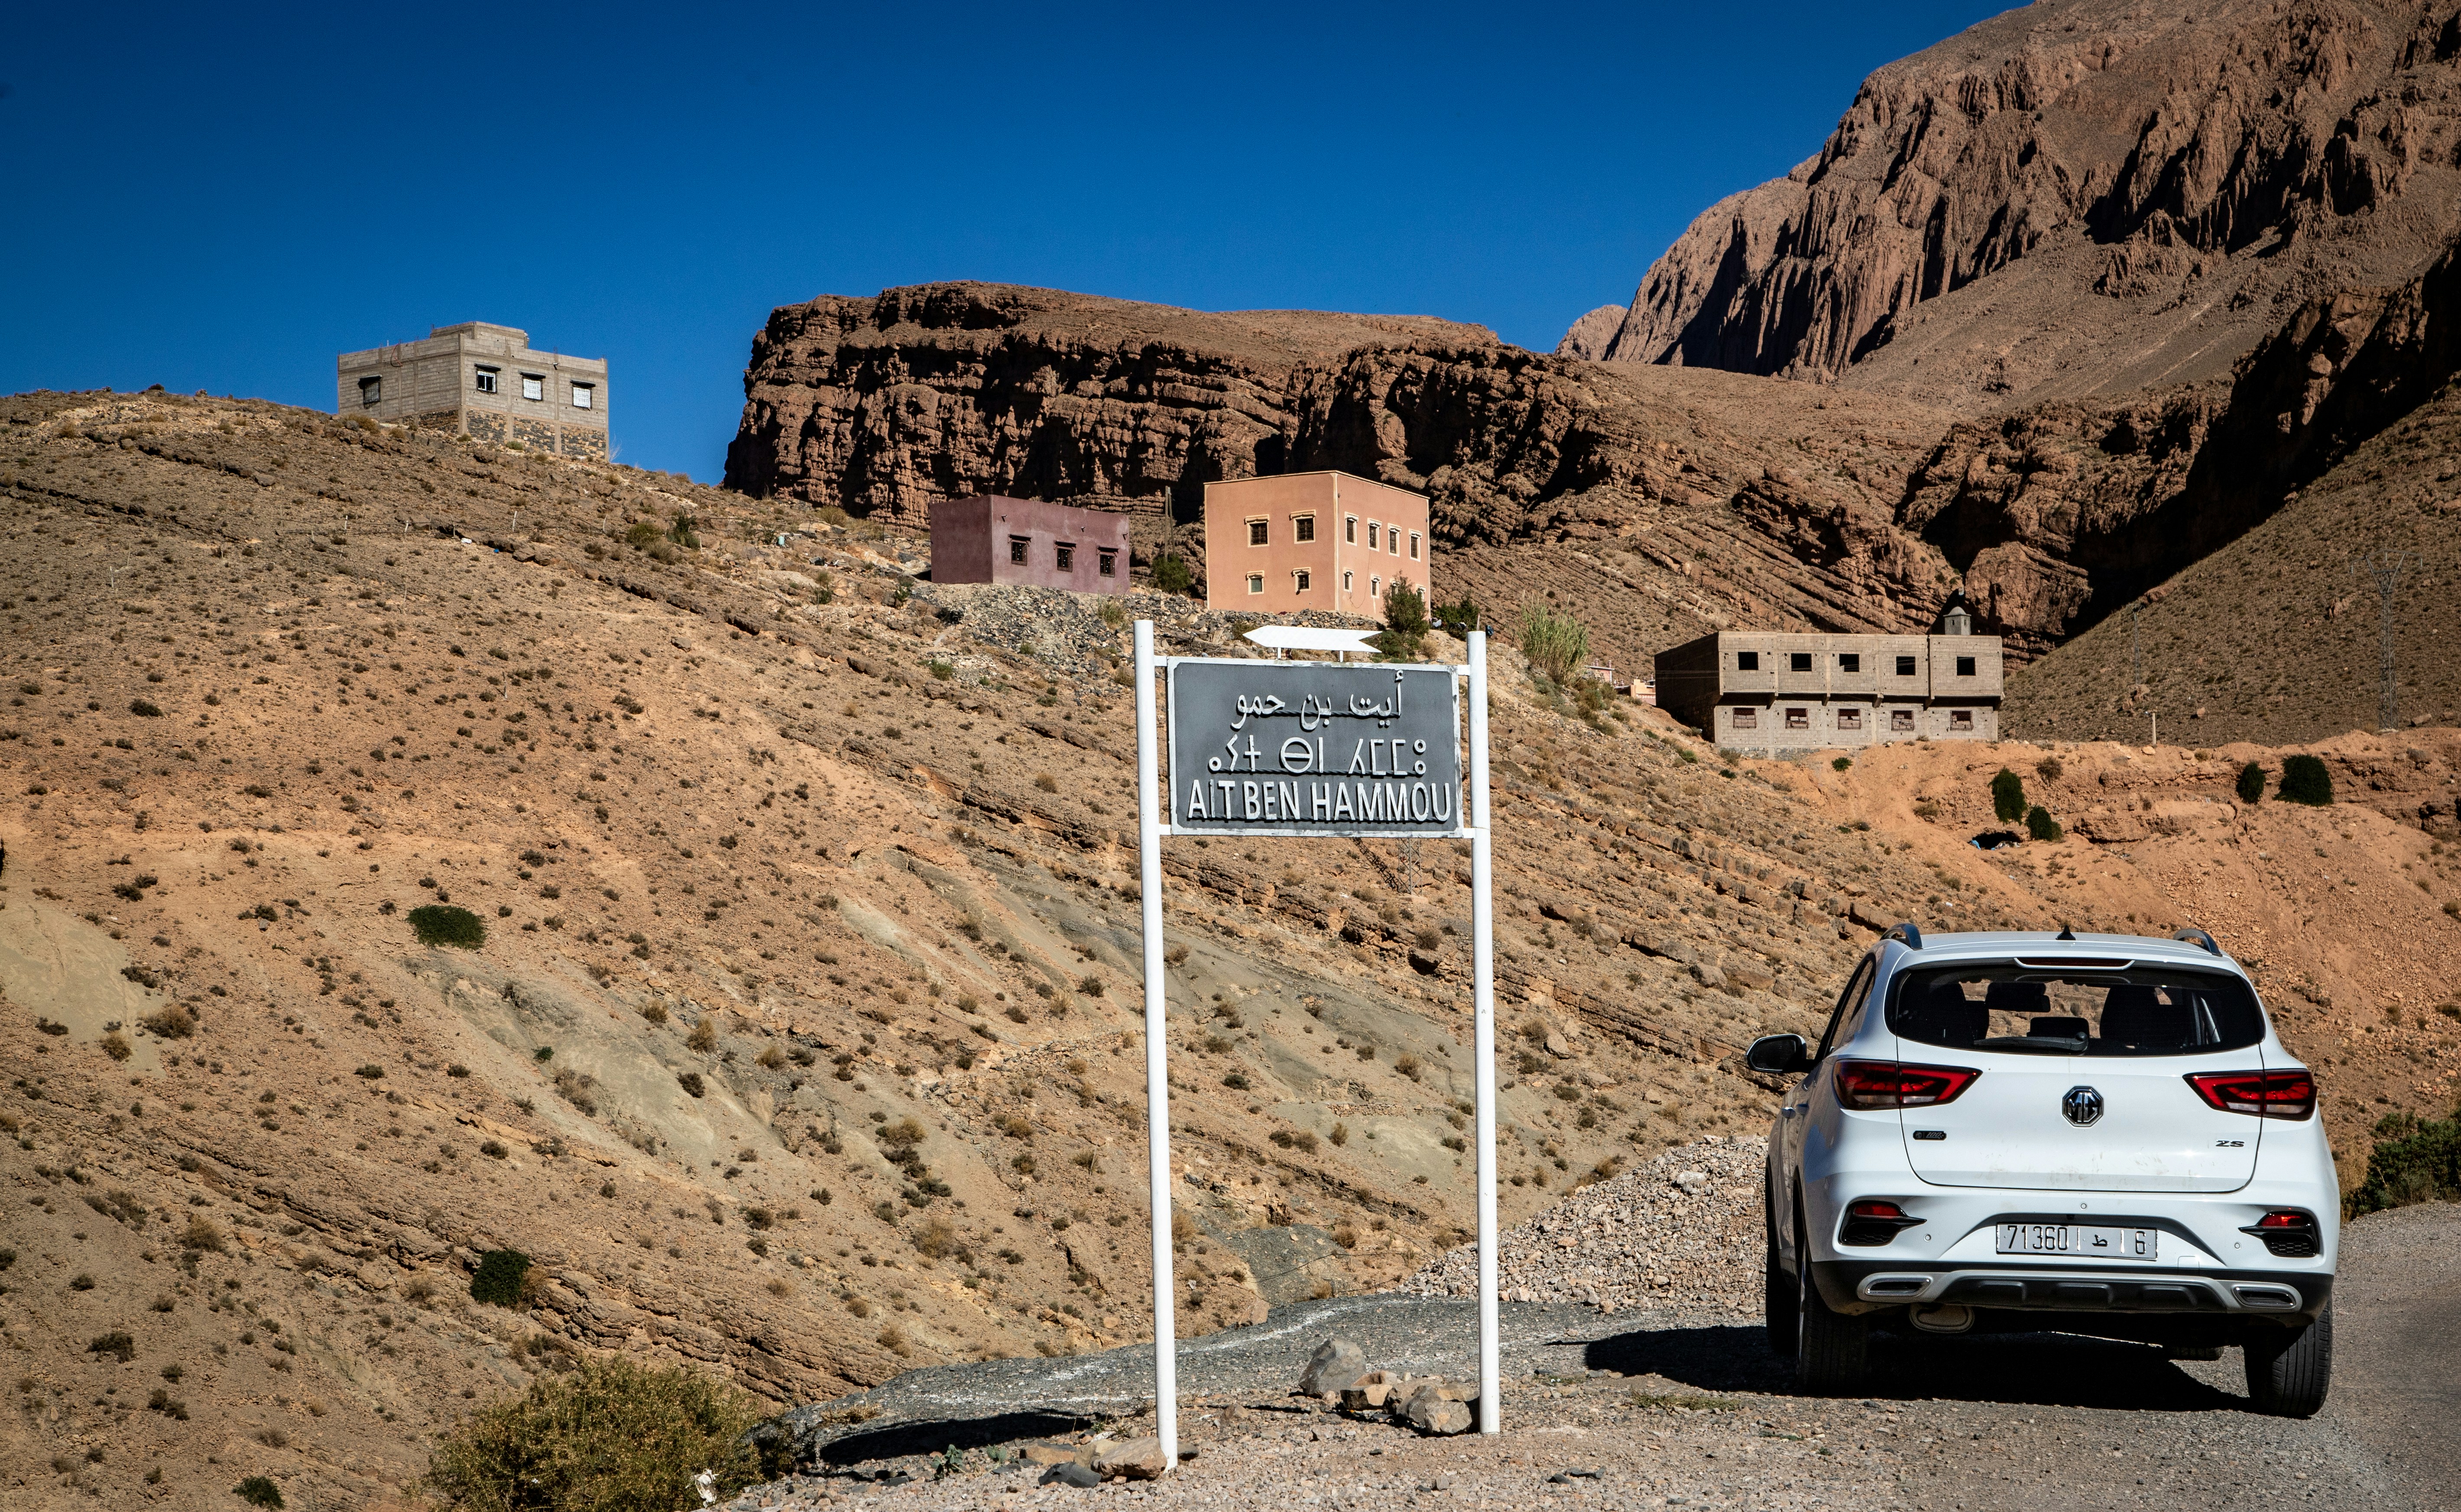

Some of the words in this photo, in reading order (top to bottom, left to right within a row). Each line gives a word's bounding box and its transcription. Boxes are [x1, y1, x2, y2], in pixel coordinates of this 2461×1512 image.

[1231, 695, 1285, 729] حمو
[1301, 694, 1331, 730] بن
[1350, 670, 1404, 726] أيت
[1188, 779, 1235, 819] AIT
[1244, 781, 1300, 820] BEN
[1312, 782, 1451, 821] HAMMOU
[2067, 1087, 2098, 1123] MG
[2007, 1225, 2069, 1251] 71360
[2135, 1230, 2146, 1255] 6
